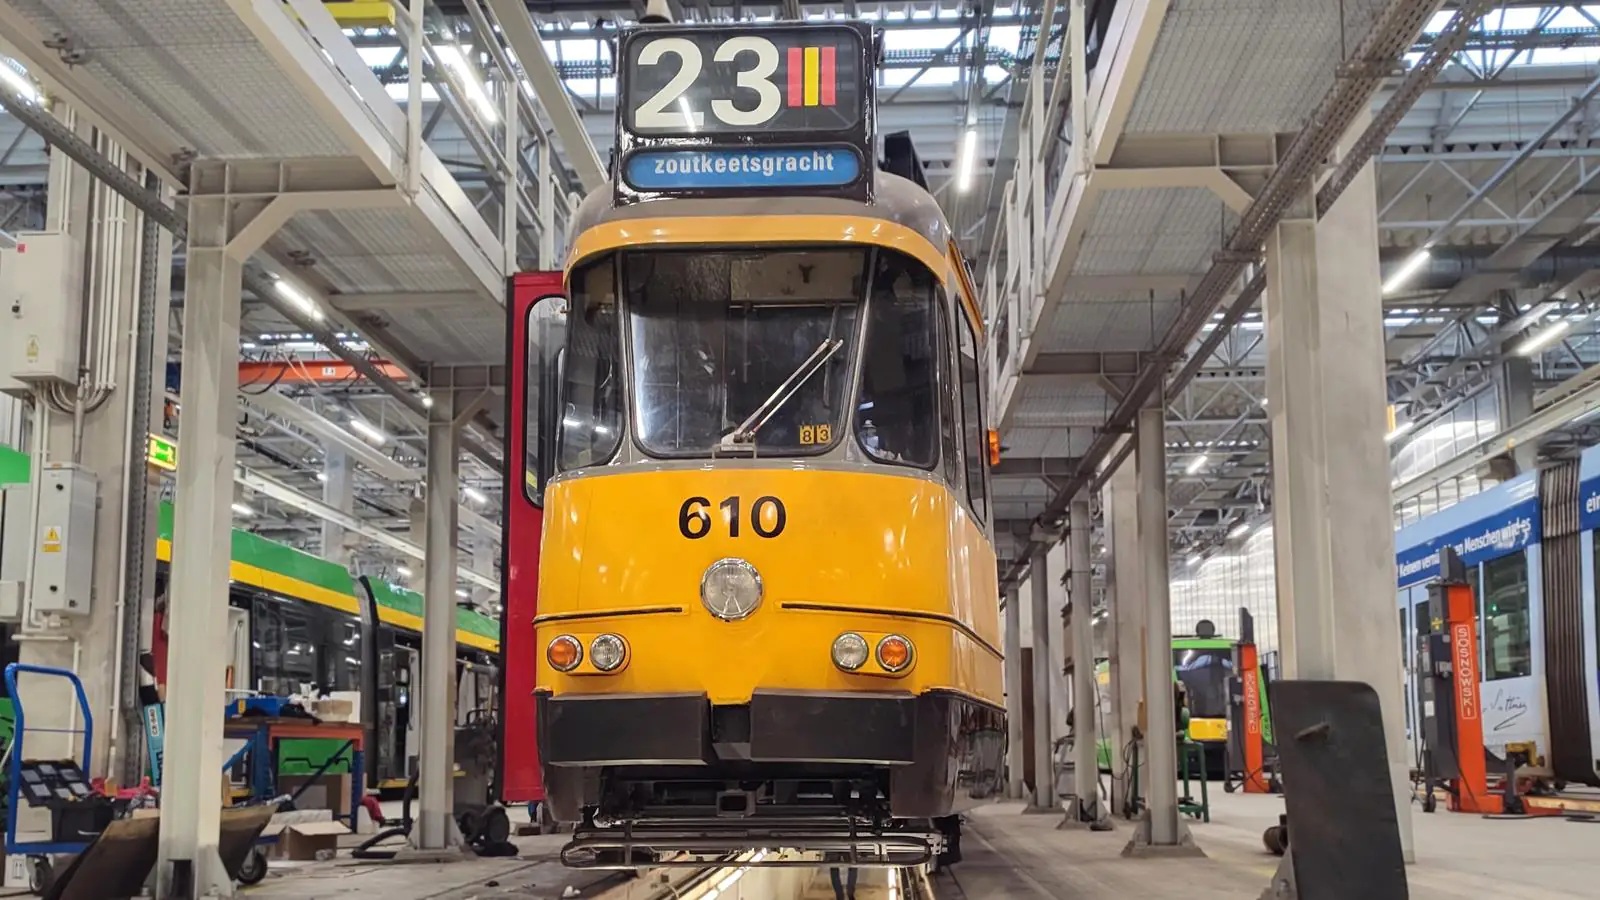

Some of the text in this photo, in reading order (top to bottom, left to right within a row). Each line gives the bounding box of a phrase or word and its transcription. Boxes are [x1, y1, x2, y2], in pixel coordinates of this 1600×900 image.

[635, 36, 781, 127] 23
[655, 152, 834, 176] zoutkeetsgracht
[679, 496, 786, 539] 610
[1464, 529, 1500, 554] Menschen
[1458, 627, 1473, 717] SOSNOWSKI
